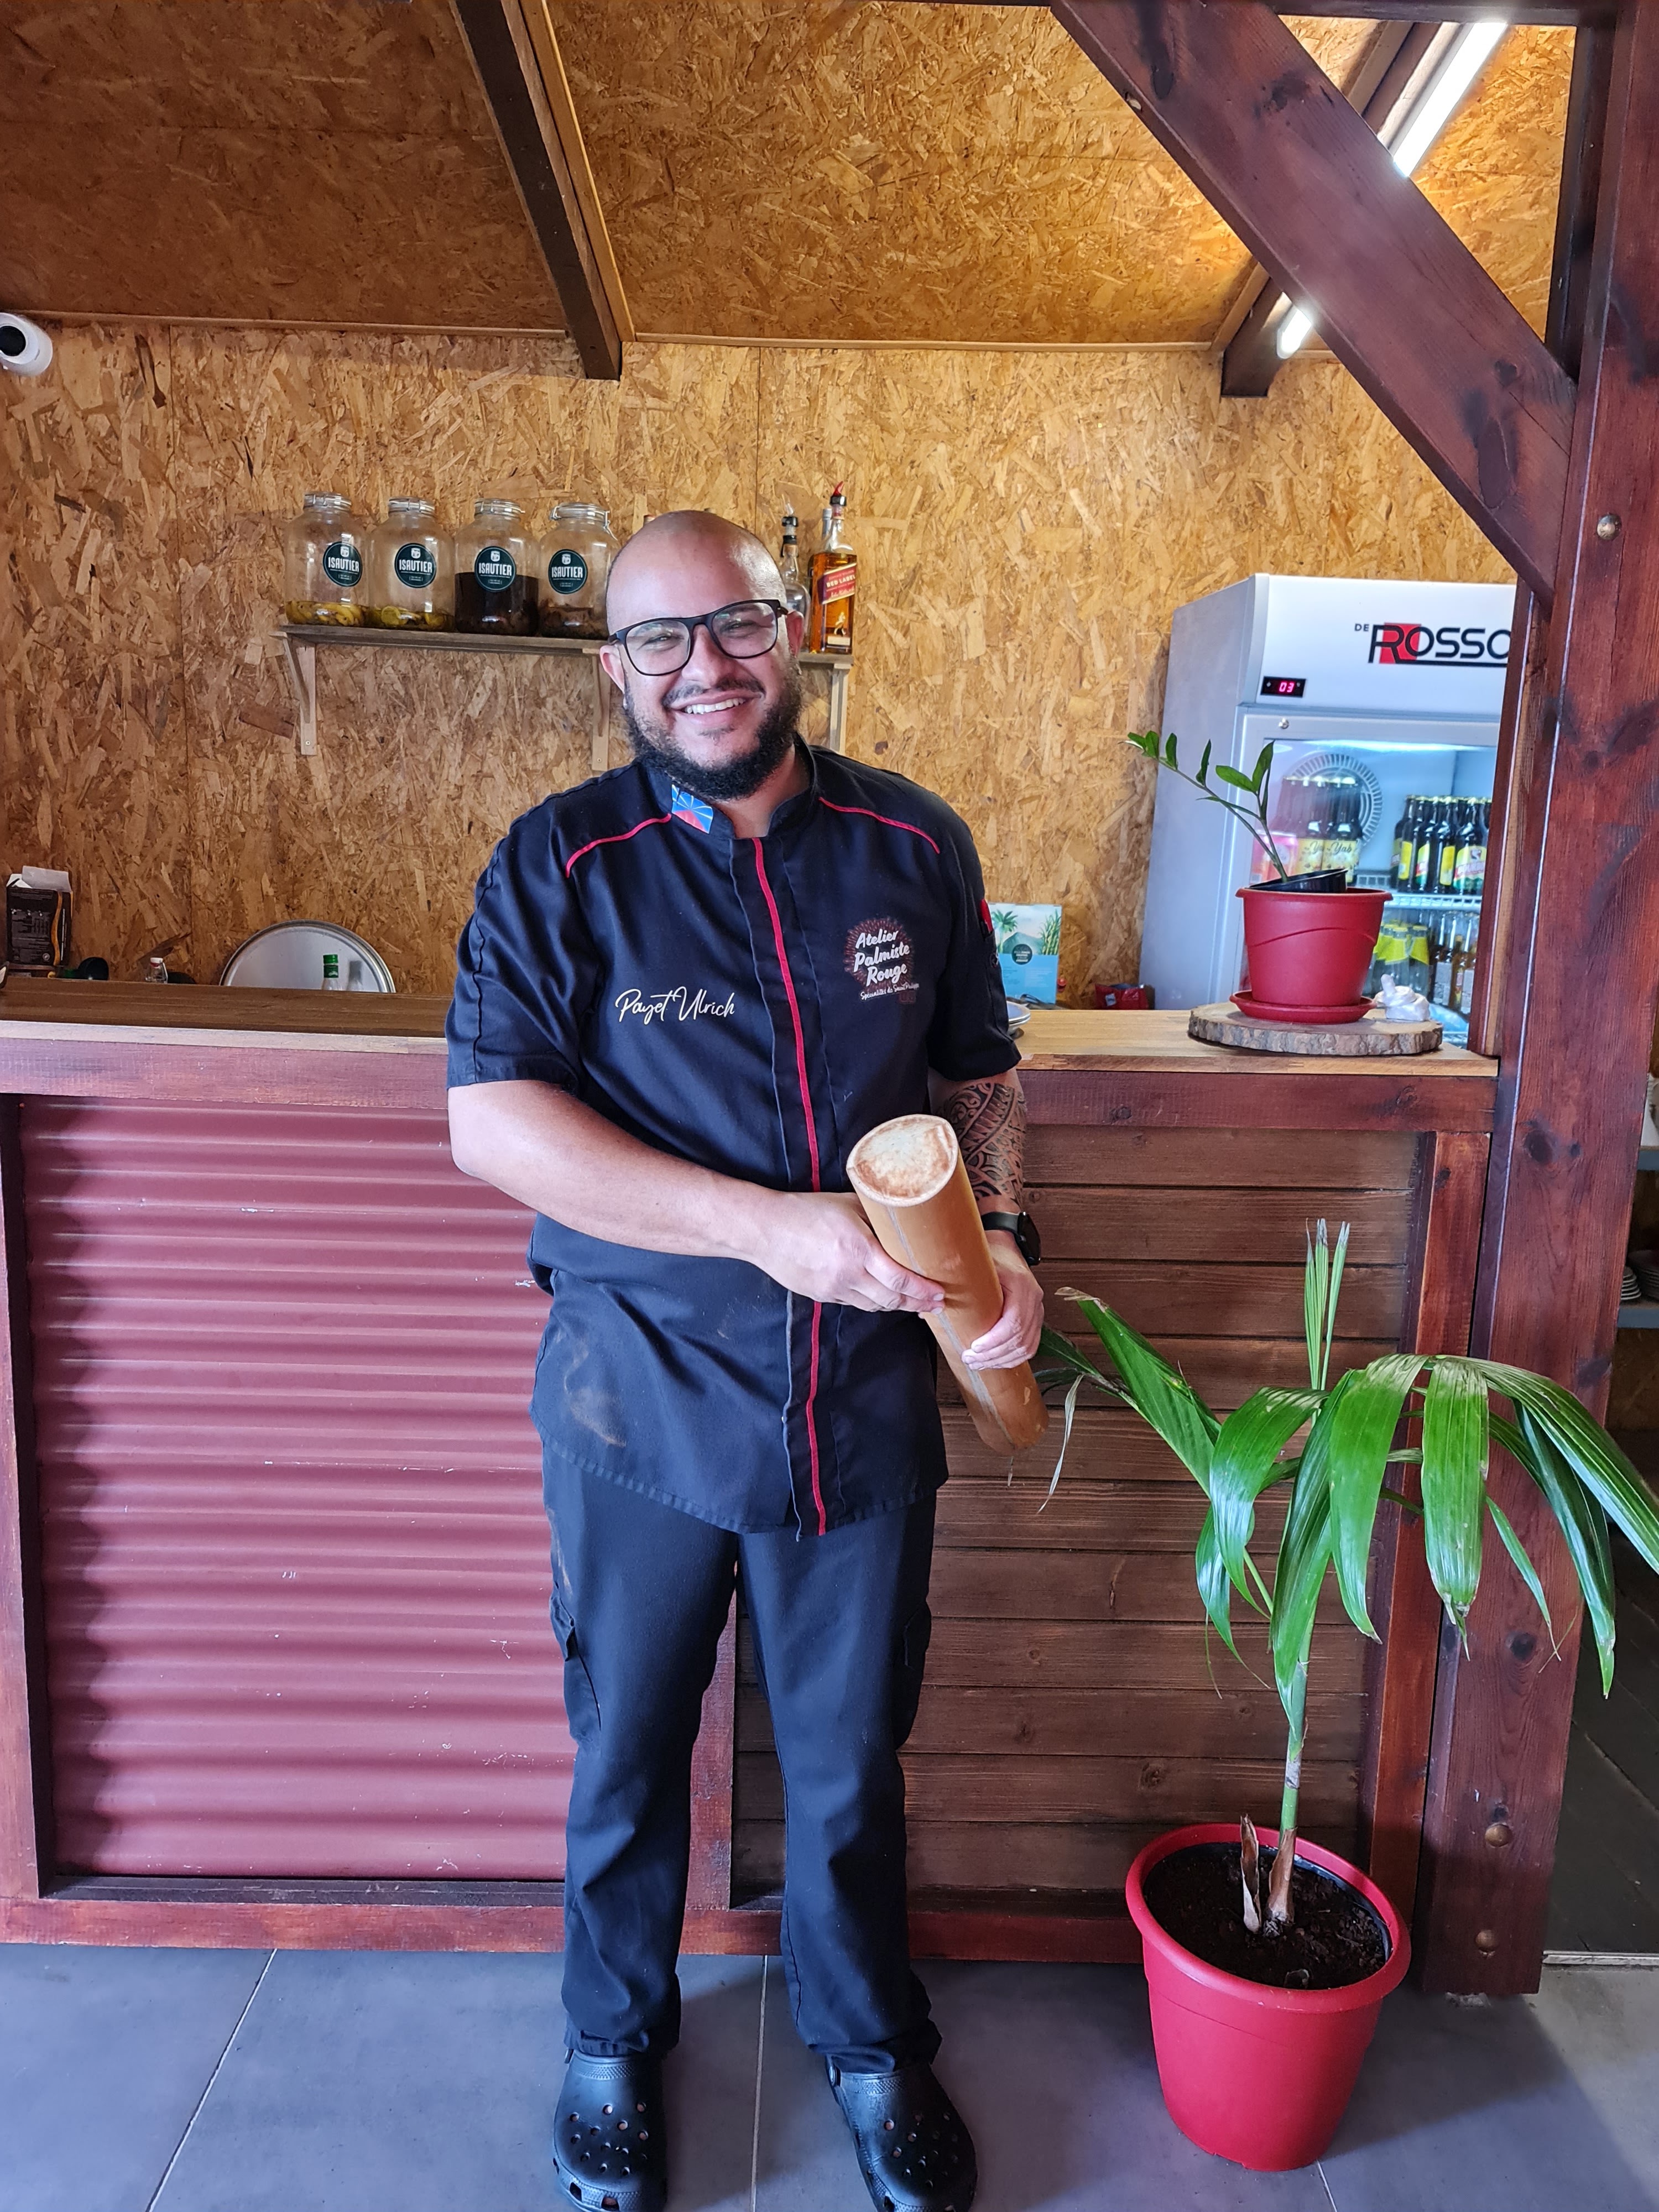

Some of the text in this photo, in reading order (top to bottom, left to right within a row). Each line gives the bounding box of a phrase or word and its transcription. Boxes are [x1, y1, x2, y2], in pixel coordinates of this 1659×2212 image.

[328, 556, 359, 572] ISAUTIER
[399, 559, 432, 573] ISAUTIER
[478, 562, 512, 576] ISAUTIER
[551, 566, 583, 578] ISAUTIER
[839, 574, 855, 583] LABEL
[1354, 623, 1511, 664] DE ROSSO
[1279, 682, 1295, 693] 03
[855, 928, 899, 949] Atelier
[853, 941, 910, 973] Palmiste
[866, 963, 908, 987] Rouge
[615, 986, 735, 1025] Payet Ulrich
